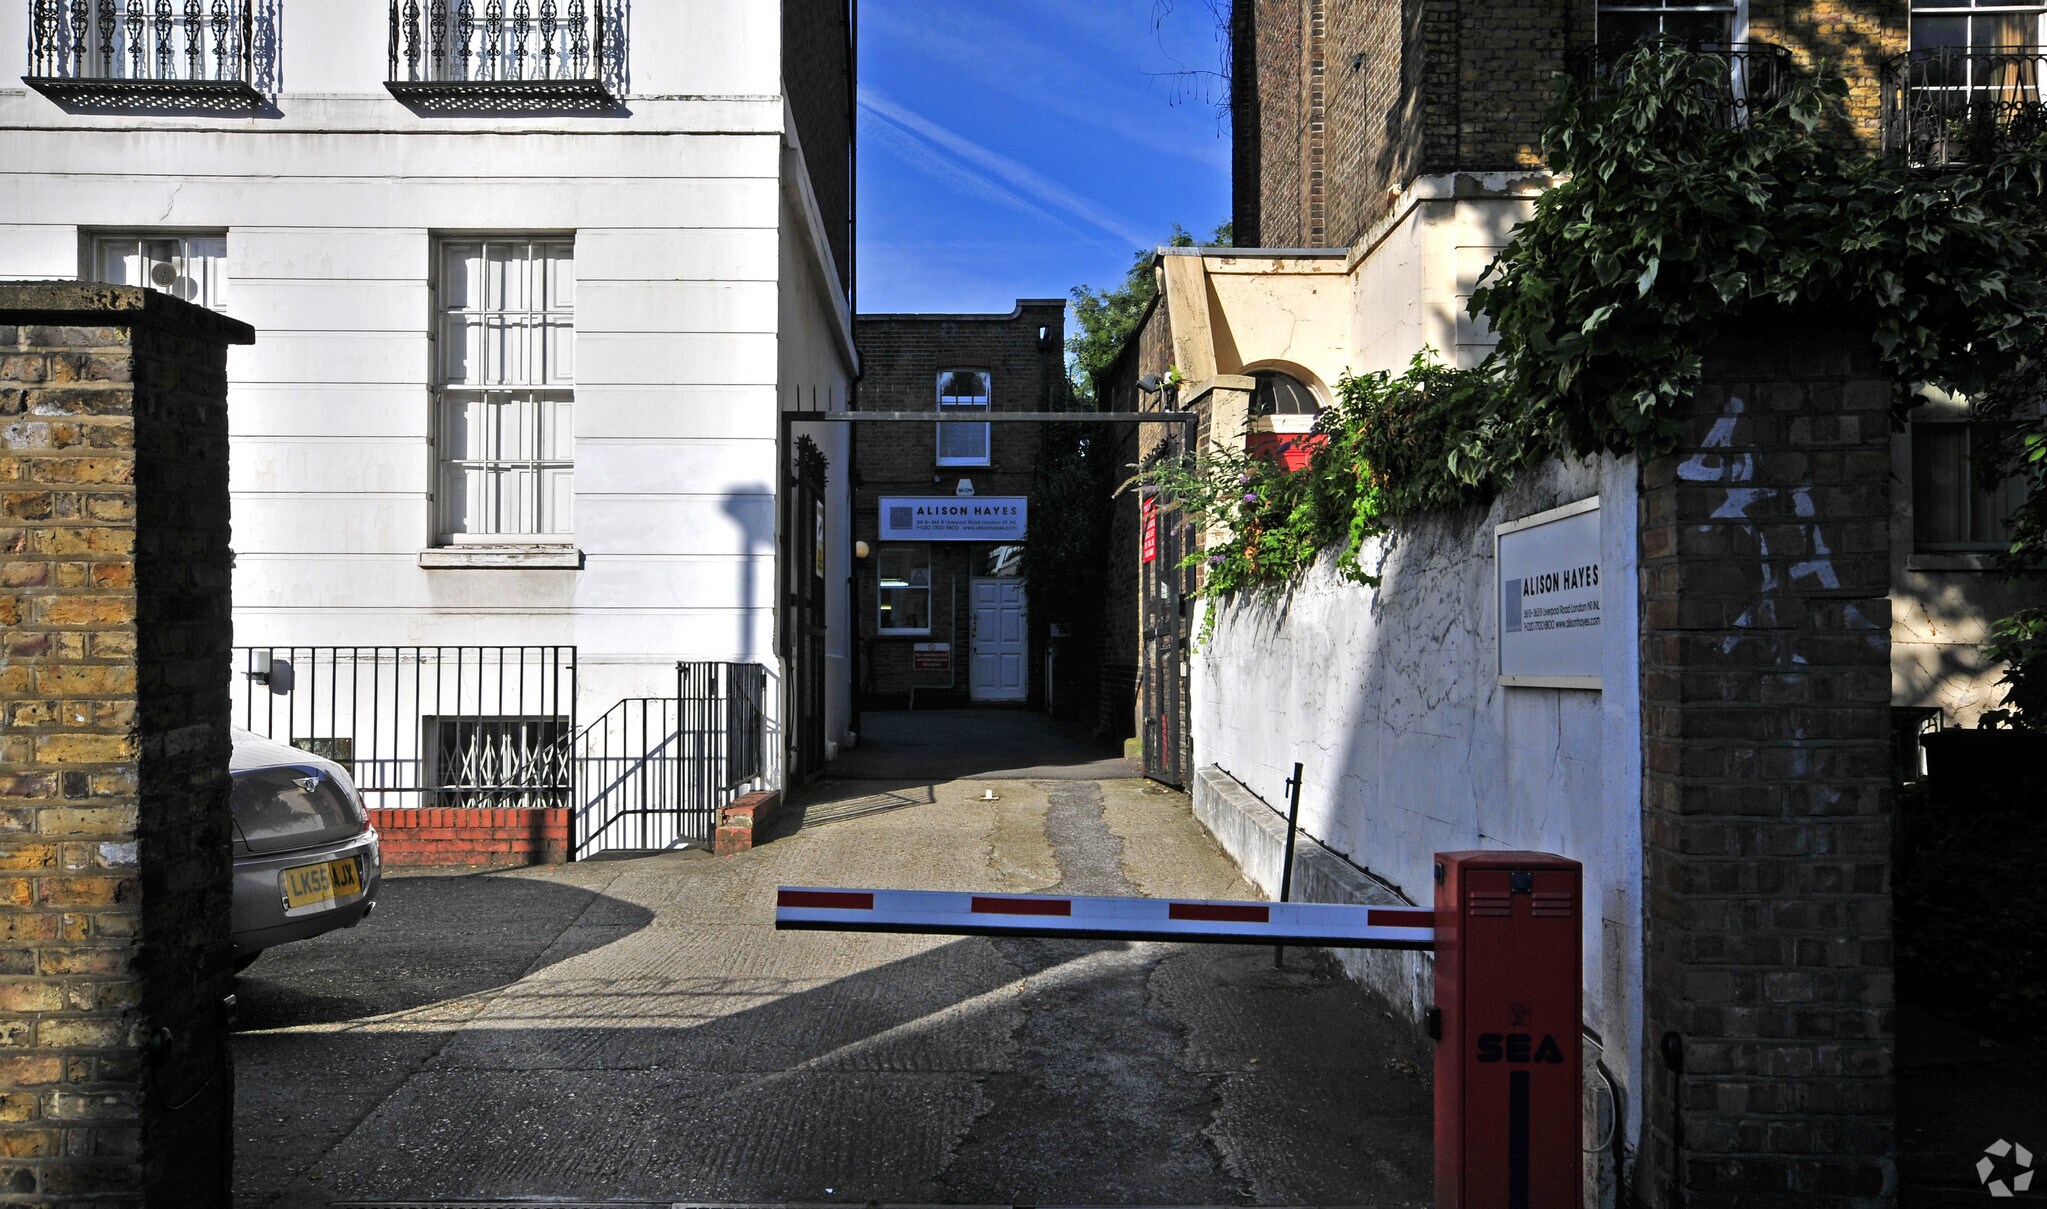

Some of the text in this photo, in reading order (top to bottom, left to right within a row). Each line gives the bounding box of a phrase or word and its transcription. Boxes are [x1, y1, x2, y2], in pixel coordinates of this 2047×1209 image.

[917, 507, 1017, 516] ALISON HAYES
[1523, 564, 1599, 597] ALISON HAYES
[1560, 604, 1570, 614] Road
[1571, 602, 1586, 613] London
[1556, 617, 1601, 629] www.alisonhayes.com
[290, 864, 355, 896] LK55 AJX
[1477, 1033, 1564, 1064] SEA
